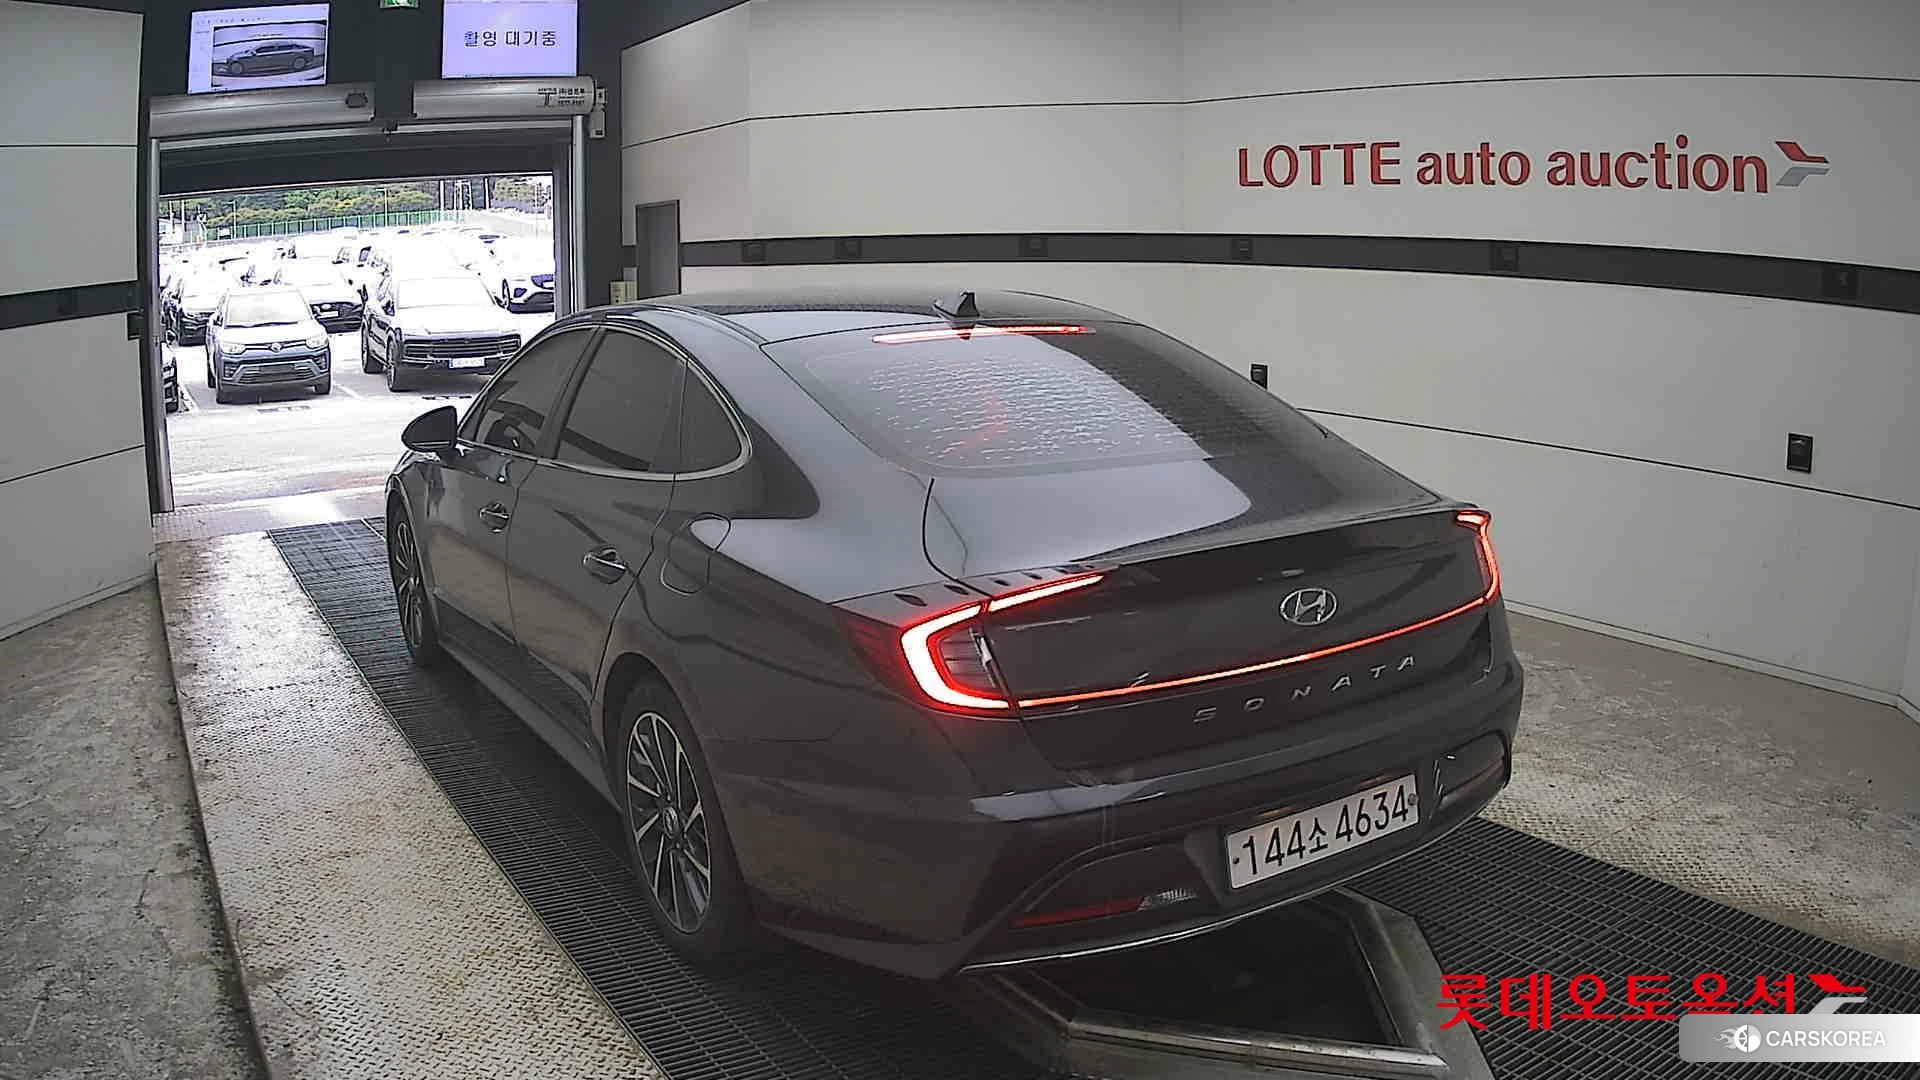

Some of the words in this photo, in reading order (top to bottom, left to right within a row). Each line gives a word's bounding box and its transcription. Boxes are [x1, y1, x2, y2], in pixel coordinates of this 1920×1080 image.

[505, 31, 556, 47] 대기중
[1238, 140, 1400, 187] LOTTE
[1416, 141, 1532, 187] auto
[1546, 134, 1770, 193] auction
[1193, 655, 1416, 722] SONATA
